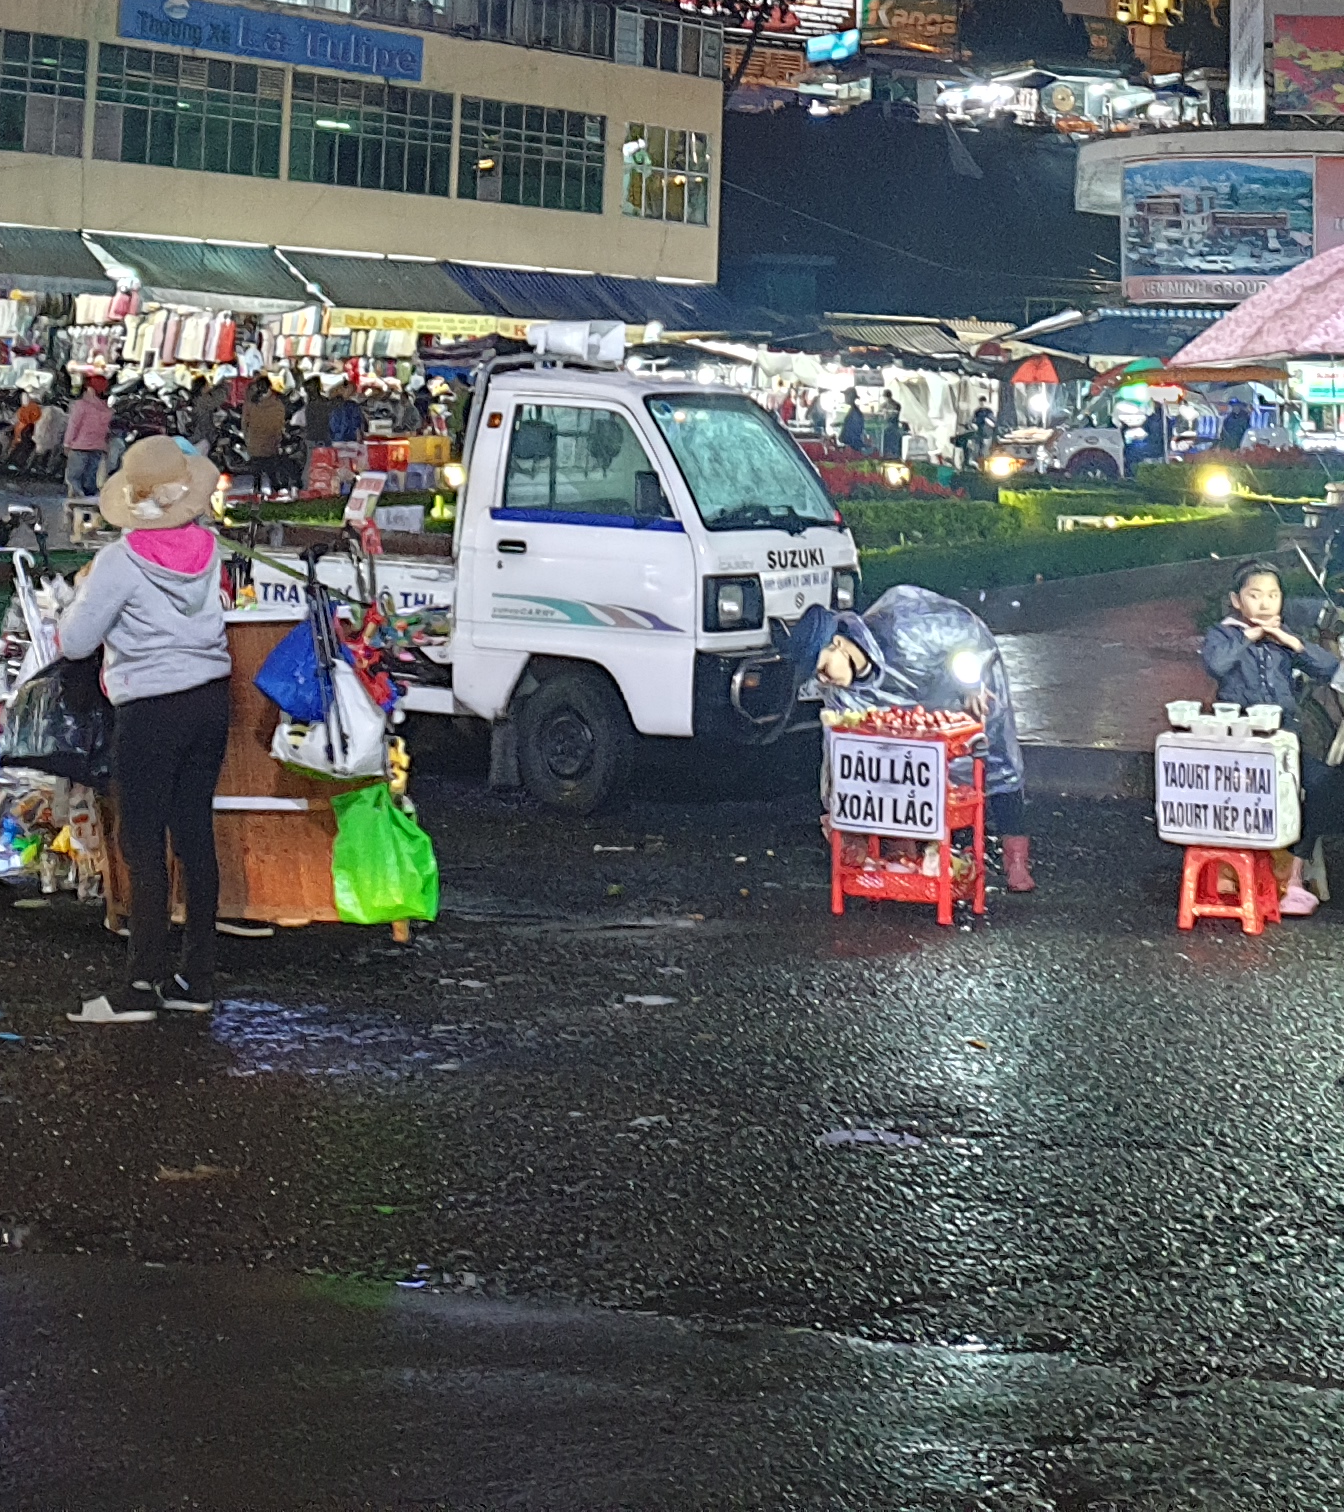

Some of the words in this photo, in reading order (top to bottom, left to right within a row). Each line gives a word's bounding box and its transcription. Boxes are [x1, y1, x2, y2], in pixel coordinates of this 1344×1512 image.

[237, 16, 288, 54] La
[300, 25, 418, 76] Tulipe
[767, 548, 825, 570] SUZUKI
[840, 749, 881, 785] DÂU
[889, 750, 931, 787] LẮC
[1162, 761, 1210, 790] YAOURT
[1245, 767, 1271, 794] MAI
[836, 791, 885, 824] XOÀI
[892, 791, 934, 827] LẮC
[1161, 800, 1208, 830] YAOURT
[1213, 796, 1239, 833] NẾP
[1243, 796, 1275, 835] CẨM
